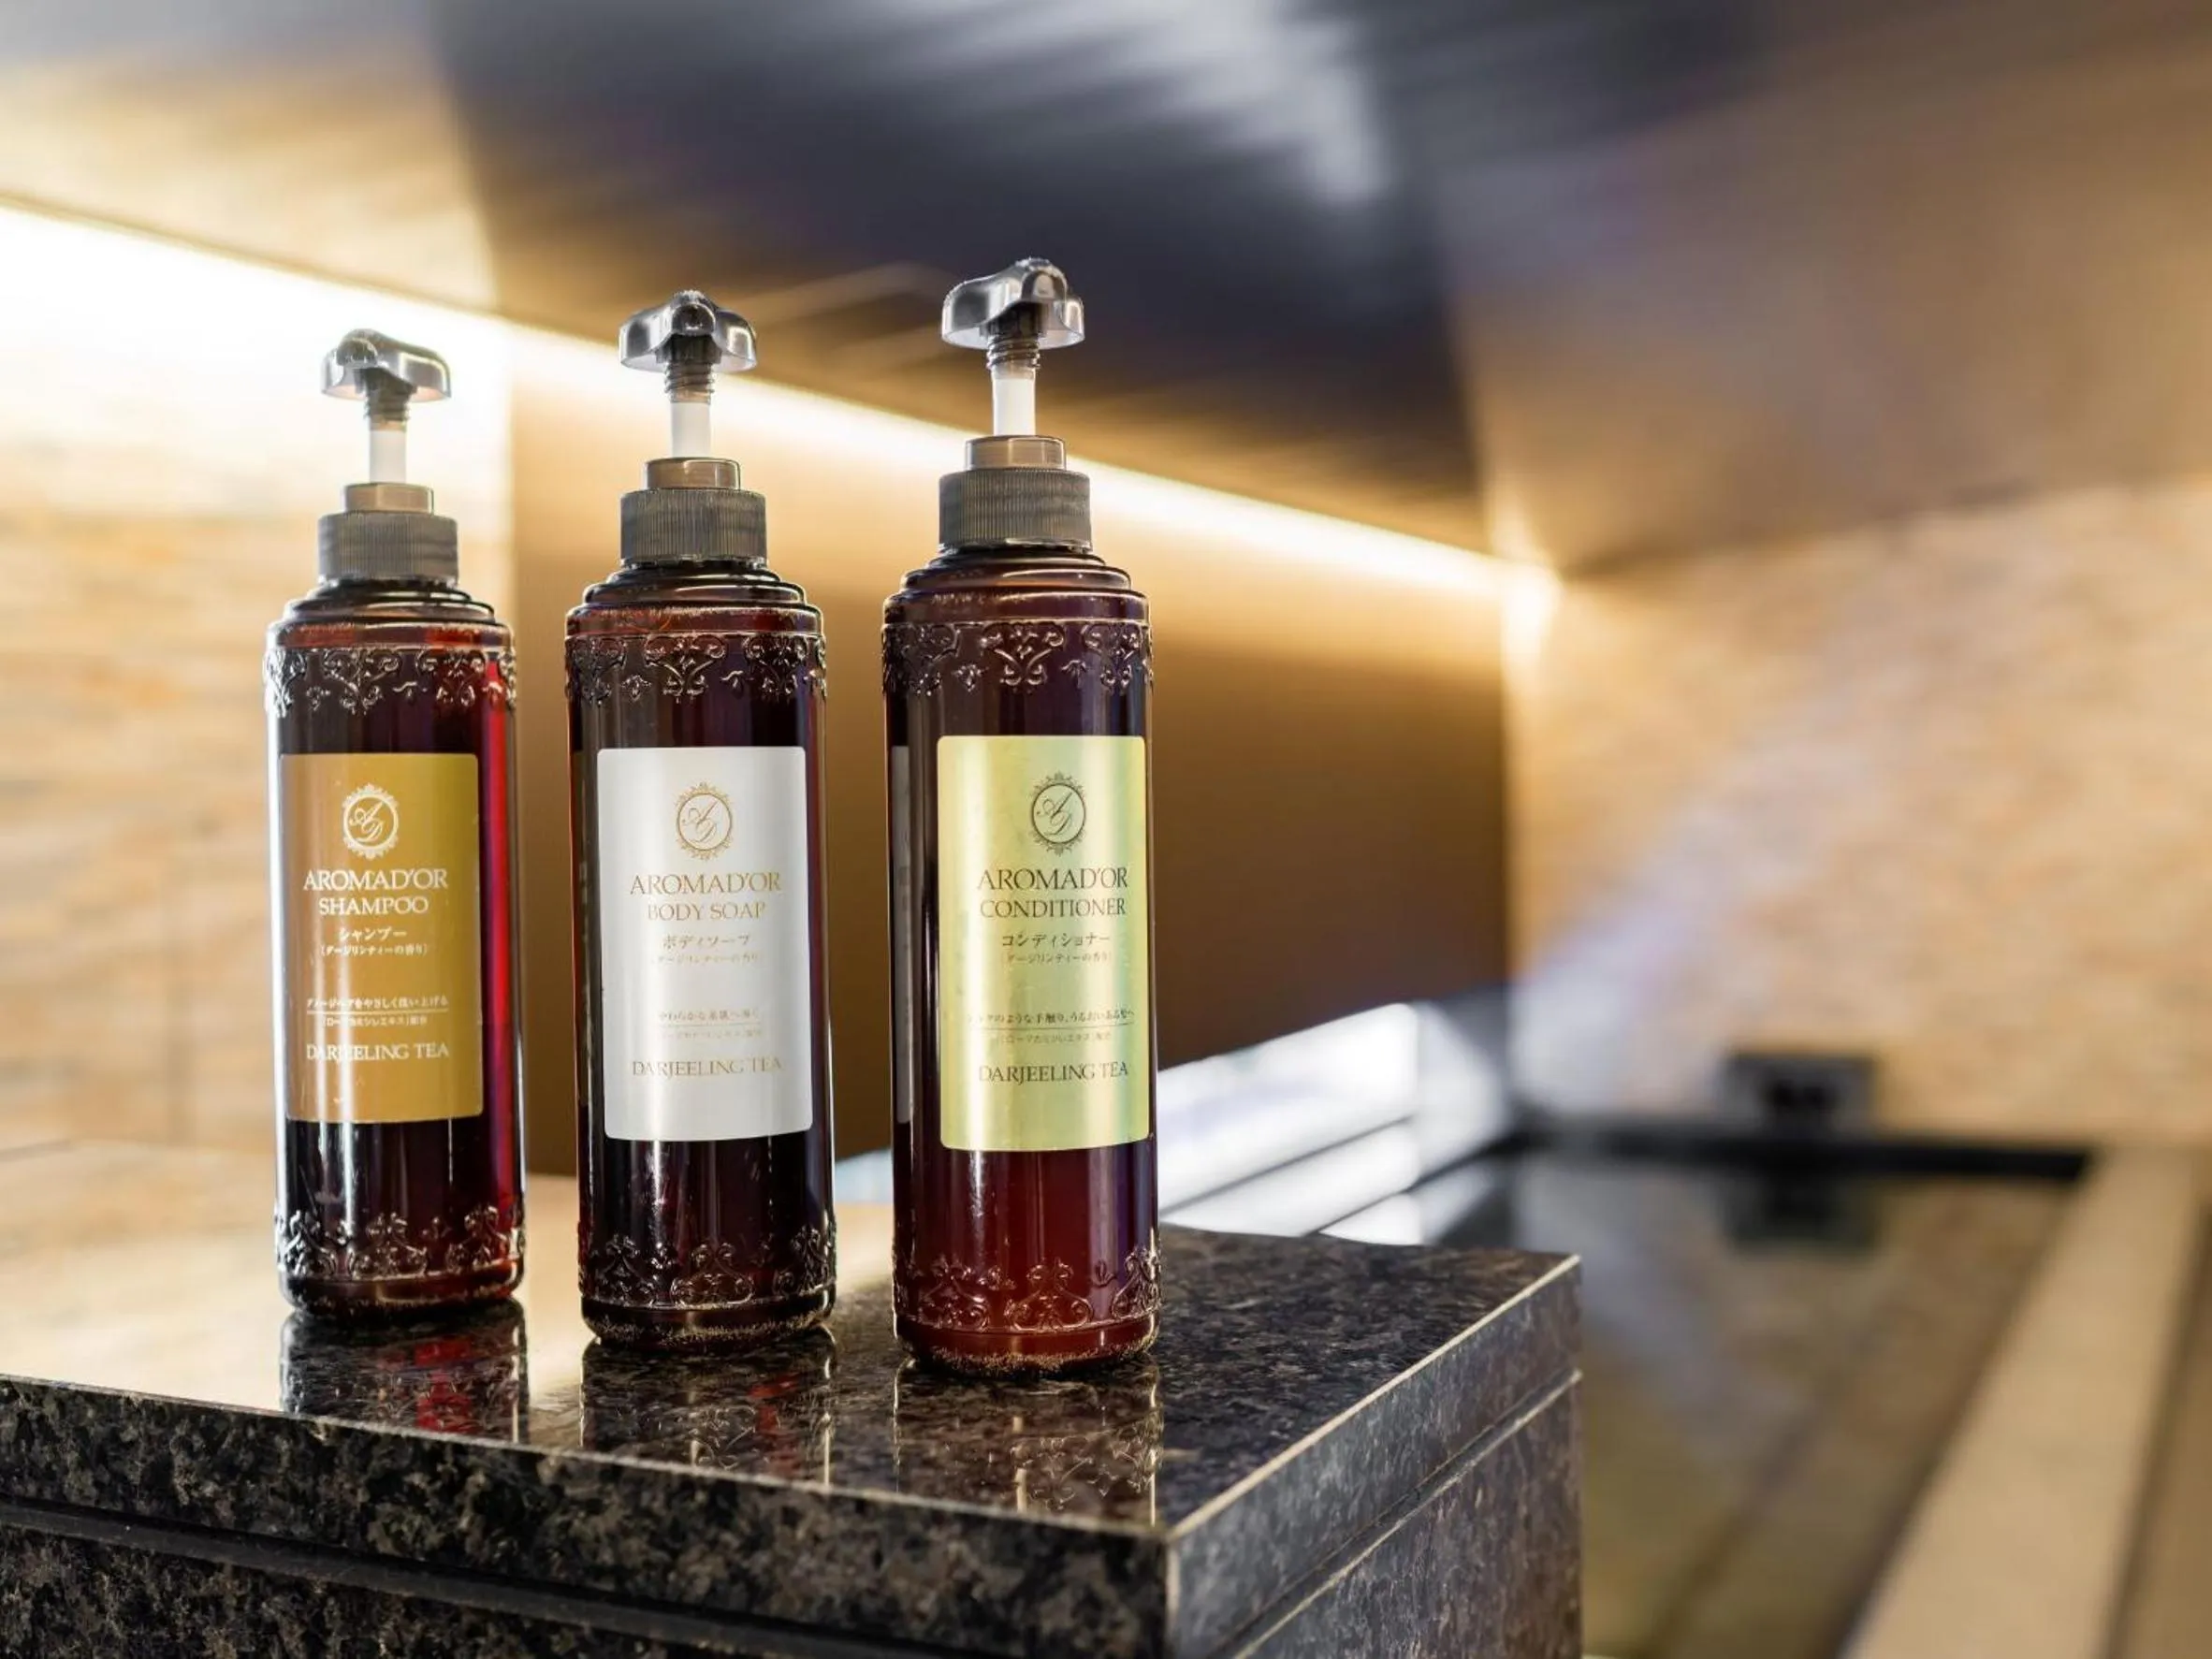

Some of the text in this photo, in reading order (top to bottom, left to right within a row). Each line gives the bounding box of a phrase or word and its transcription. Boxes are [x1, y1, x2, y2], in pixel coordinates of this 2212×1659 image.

[303, 868, 448, 891] AROMAD'OR
[630, 872, 782, 895] AROMAD'OR
[978, 866, 1128, 890] AROMAD'OR
[318, 895, 429, 915] SHAMPOO
[648, 901, 765, 921] BODY SOAP
[980, 897, 1126, 918] CONDITIONER
[339, 925, 407, 942] シャンプー
[663, 934, 750, 949] ボディソープ
[1002, 932, 1110, 948] コンディショナー
[307, 1042, 449, 1064] DARJEELING TEA
[633, 1056, 784, 1079] DARJEELING TEA
[979, 1061, 1128, 1085] DARJEELING TEA
